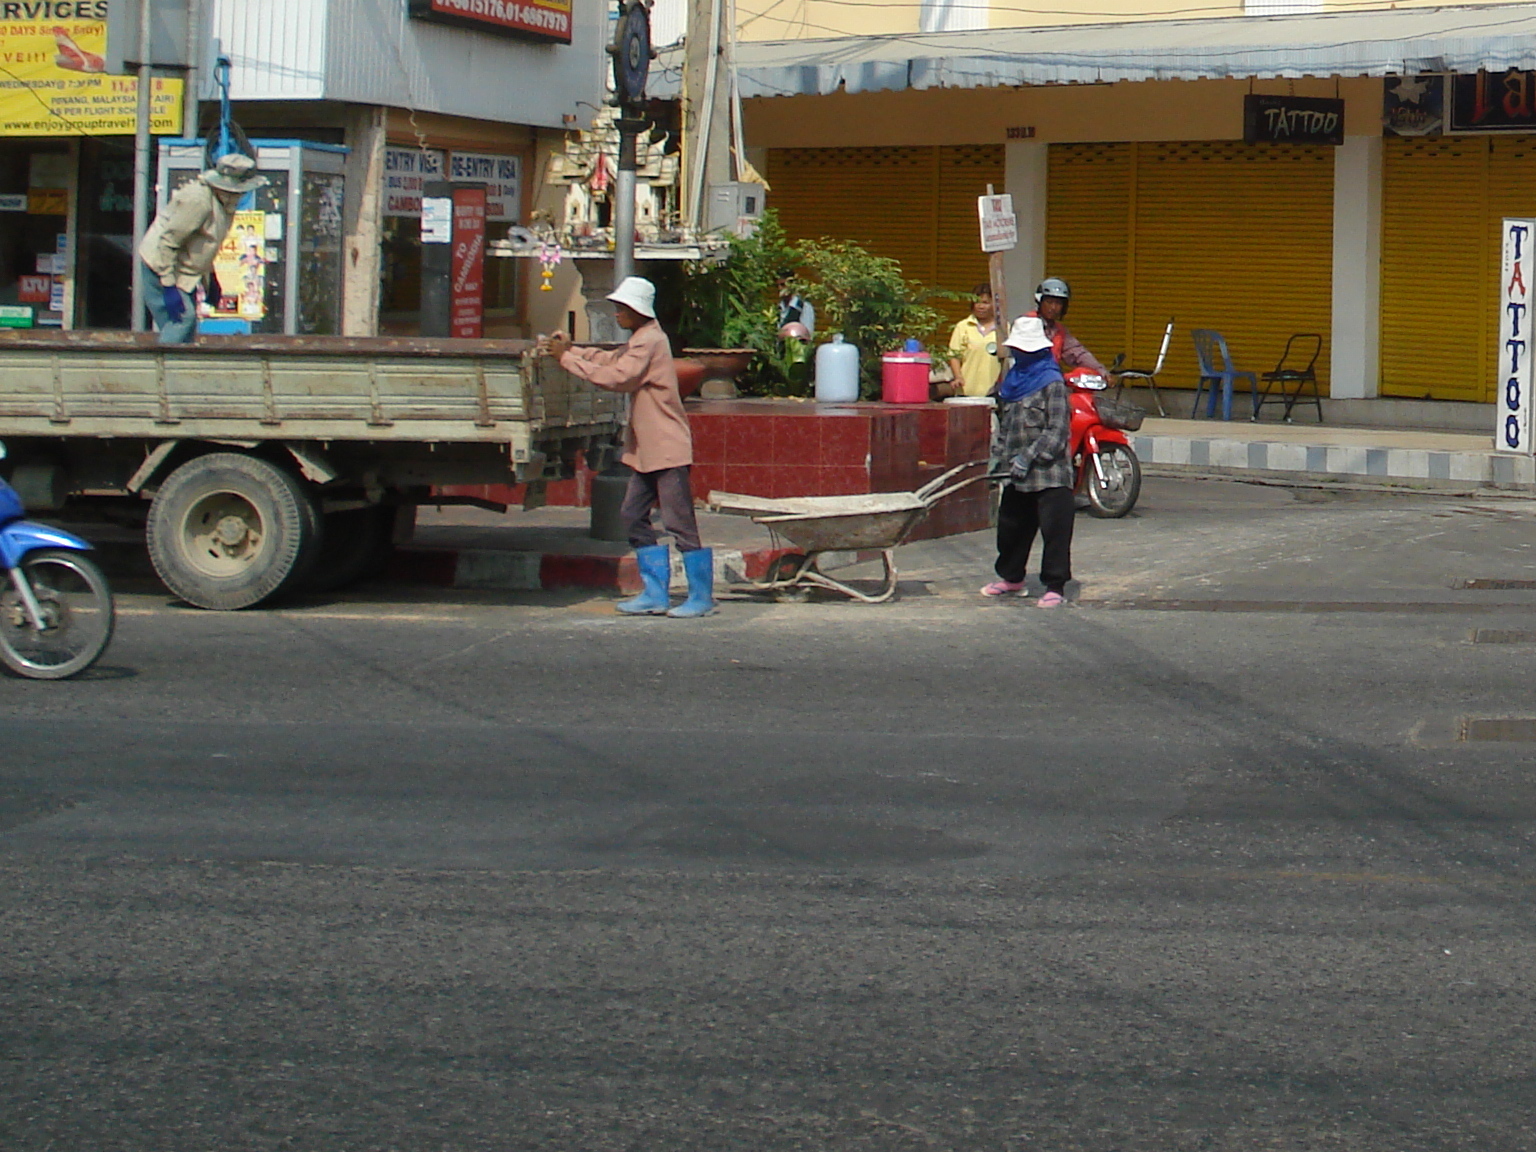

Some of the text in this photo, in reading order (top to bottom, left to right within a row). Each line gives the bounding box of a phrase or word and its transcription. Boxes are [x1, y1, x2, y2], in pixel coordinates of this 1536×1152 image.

[10, 26, 36, 35] DAYS
[92, 95, 136, 105] MALAYSIA
[64, 107, 82, 116] PER
[84, 107, 115, 116] FLIGHT
[1264, 107, 1338, 139] TATTOO
[451, 156, 516, 179] RE-ENTRY VISA
[22, 277, 49, 292] LTU
[1505, 225, 1528, 448] TATTOO
